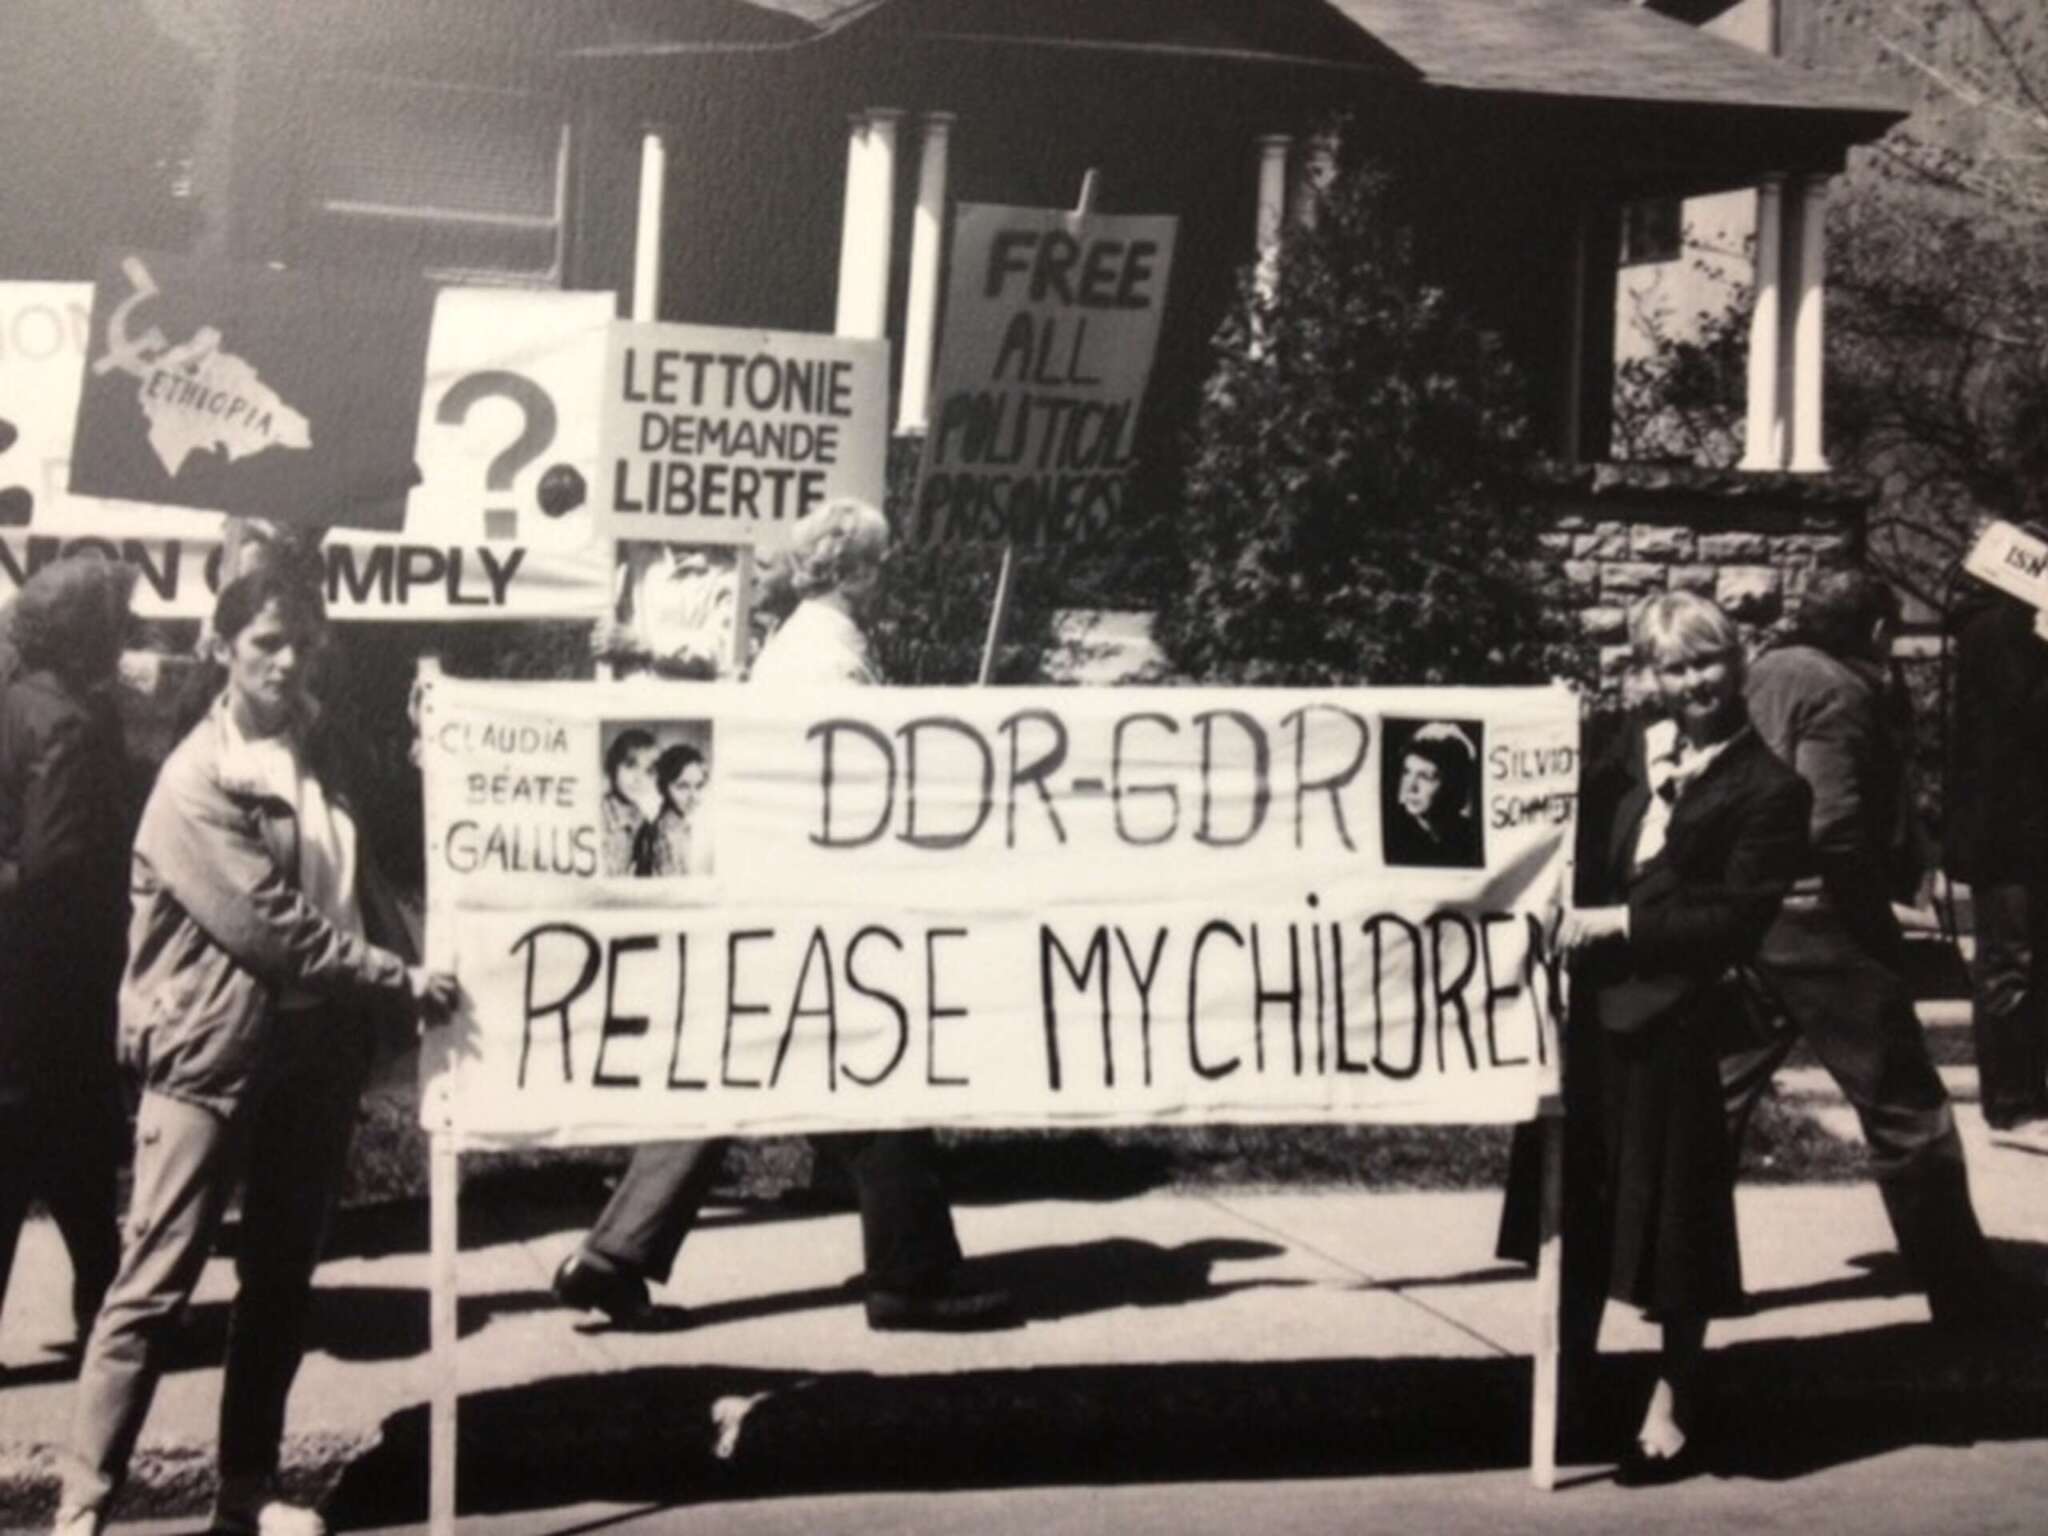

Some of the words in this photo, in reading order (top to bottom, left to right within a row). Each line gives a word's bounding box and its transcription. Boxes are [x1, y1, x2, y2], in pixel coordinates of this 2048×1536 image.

[984, 229, 1157, 309] FREE
[622, 346, 854, 419] LETTONIE
[991, 309, 1102, 386] ALL
[145, 367, 274, 438] ETHIOPIA
[638, 410, 839, 465] DEMANDE
[466, 772, 580, 808] BEATE
[804, 703, 1371, 852] DDR-GDR
[1488, 745, 1575, 781] SILVIO
[444, 818, 598, 878] GALLUS
[509, 921, 970, 1093] RELEASE
[1039, 923, 1170, 1091] MY
